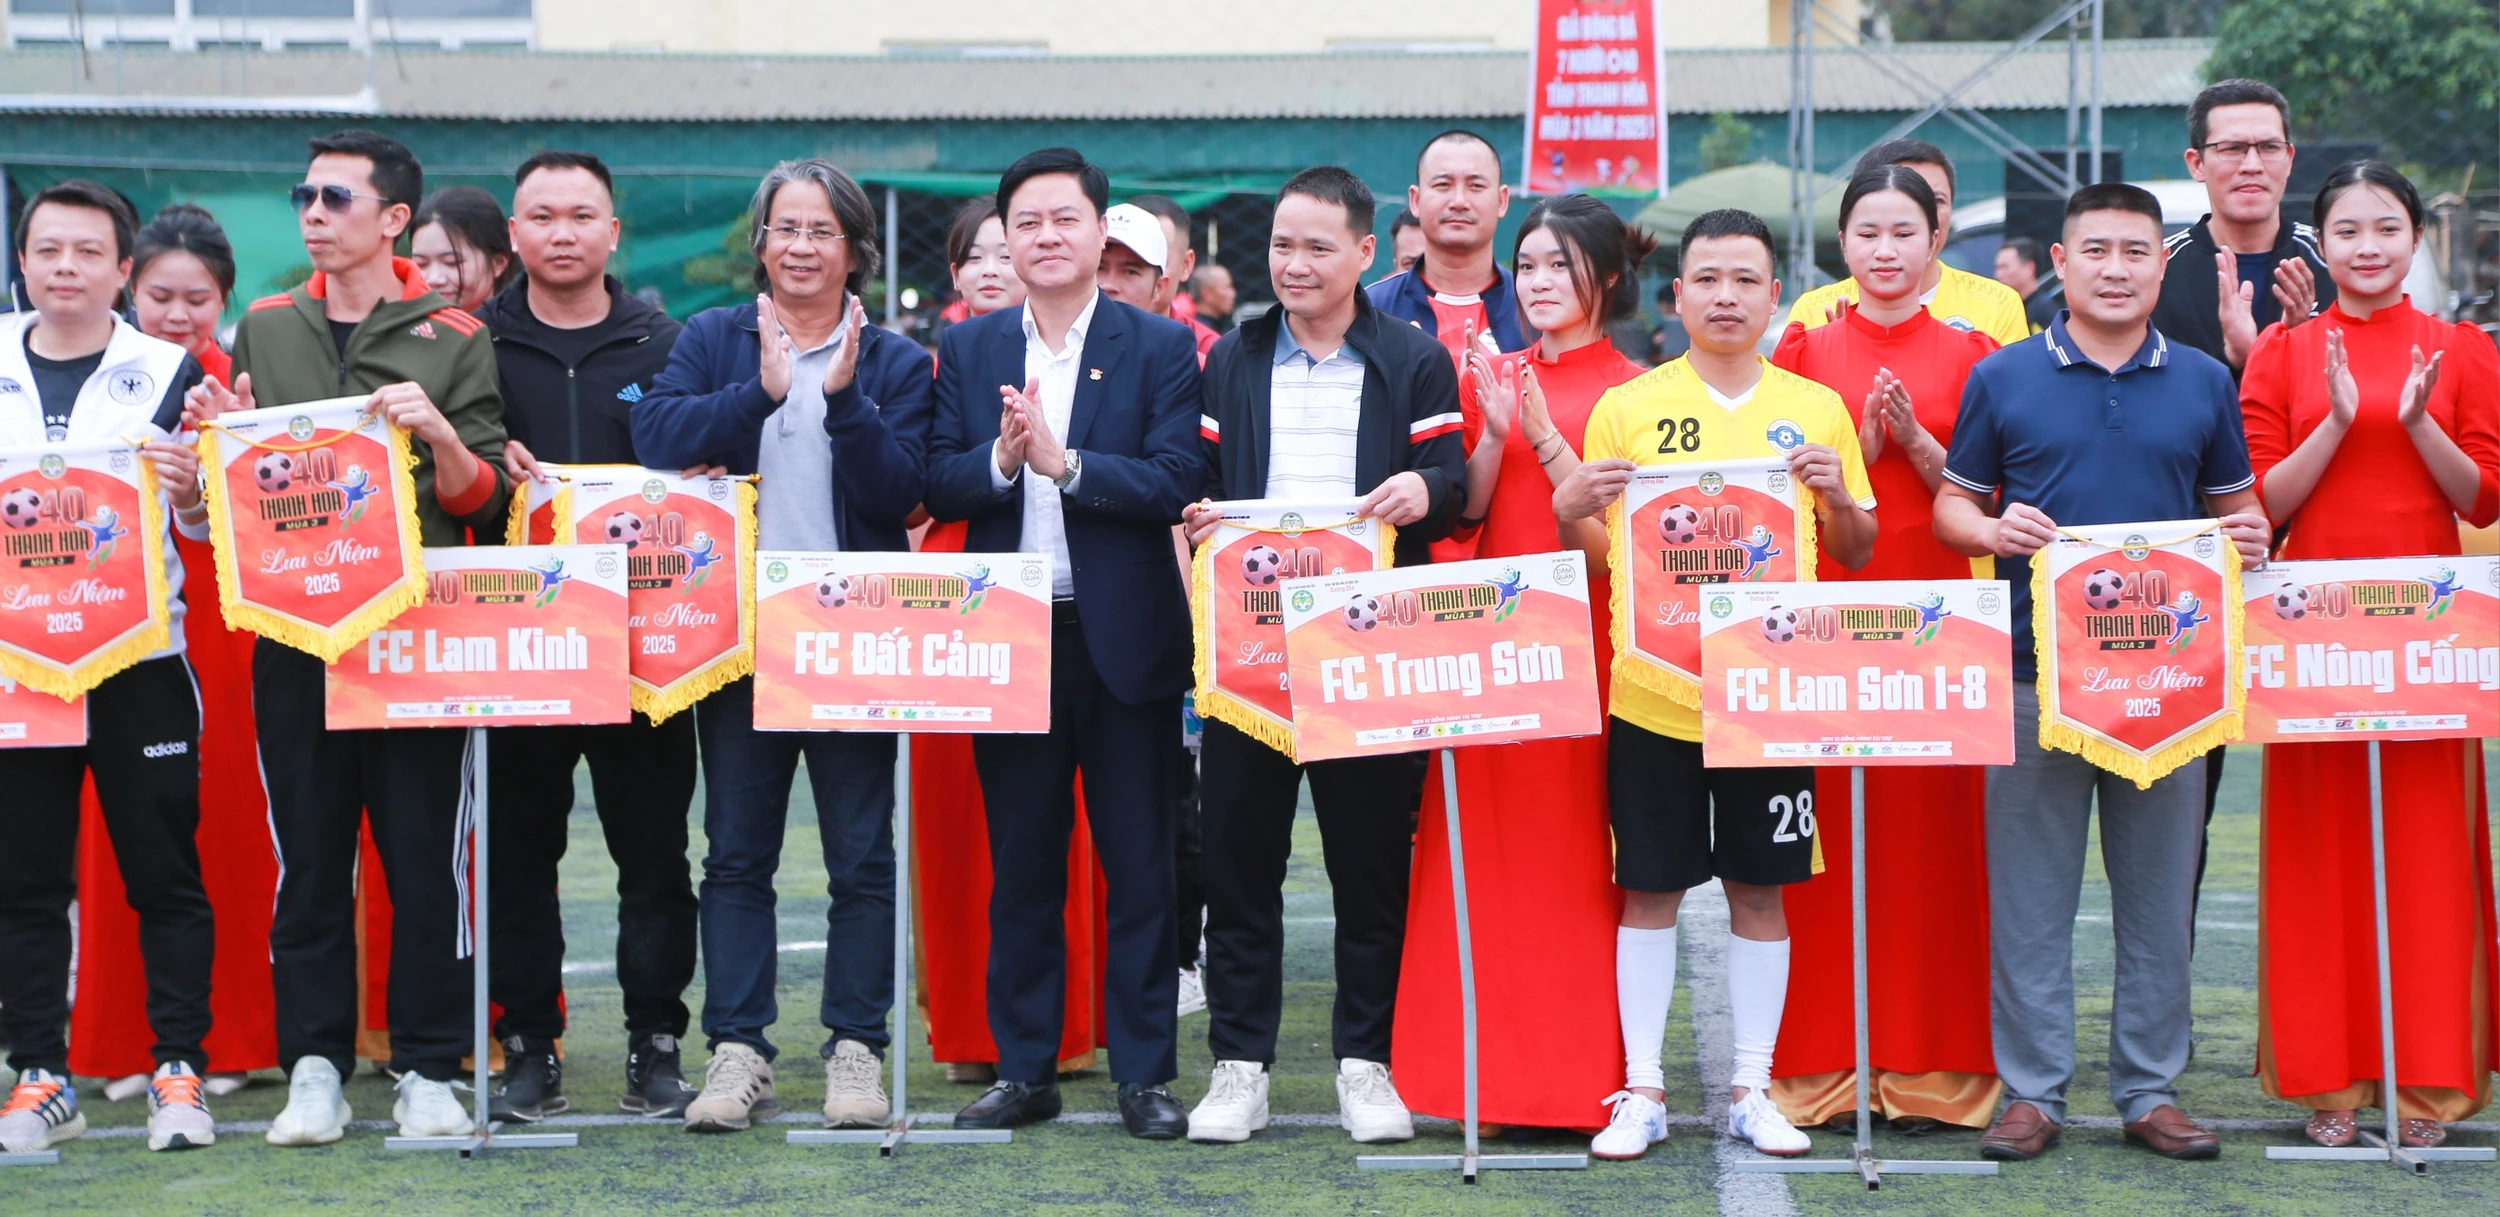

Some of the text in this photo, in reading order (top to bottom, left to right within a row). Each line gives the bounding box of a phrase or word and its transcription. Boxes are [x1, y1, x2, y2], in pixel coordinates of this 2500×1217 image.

[1576, 81, 1621, 107] THANH
[1657, 417, 1700, 453] 28
[258, 493, 306, 522] THANH
[311, 519, 319, 527] 3
[4, 532, 53, 556] THANH
[314, 537, 381, 565] Niệm
[628, 555, 651, 577] ANH
[1660, 545, 1744, 572] THANH HÓA
[304, 572, 340, 596] 2025
[463, 573, 506, 592] THANH
[655, 580, 662, 588] 3
[890, 577, 935, 597] THANH
[1712, 575, 1719, 583] 3
[1418, 588, 1463, 613] THANH
[1468, 583, 1497, 608] HÓA
[2351, 585, 2395, 605] THANH
[46, 612, 83, 633] 2025
[629, 602, 718, 629] ưu Niệm
[1266, 614, 1283, 624] MÙ
[1444, 611, 1475, 621] MÙA 3
[1839, 609, 1883, 630] THANH
[1889, 605, 1917, 630] HÓA
[2085, 610, 2171, 638] THANH HÓA
[642, 635, 676, 654] 2025
[1862, 631, 1893, 640] MÙA 3
[2111, 640, 2145, 650] MÙA 3
[368, 626, 588, 674] FC Lam Kinh
[795, 627, 1010, 685] FC Đất Cảng
[1237, 640, 1285, 666] Lưu
[1320, 656, 1368, 703] FC
[1375, 652, 1482, 697] Trung
[1491, 640, 1564, 686] Sơn
[2244, 633, 2500, 693] FC Nông Cống
[1727, 668, 1768, 712] FC
[1779, 667, 1847, 711] Lam
[1858, 666, 1924, 711] Sơn
[2080, 665, 2207, 693] Lưu Niệm
[2126, 698, 2161, 718] 2025
[143, 741, 187, 758] adidas
[1769, 790, 1814, 843] 28
